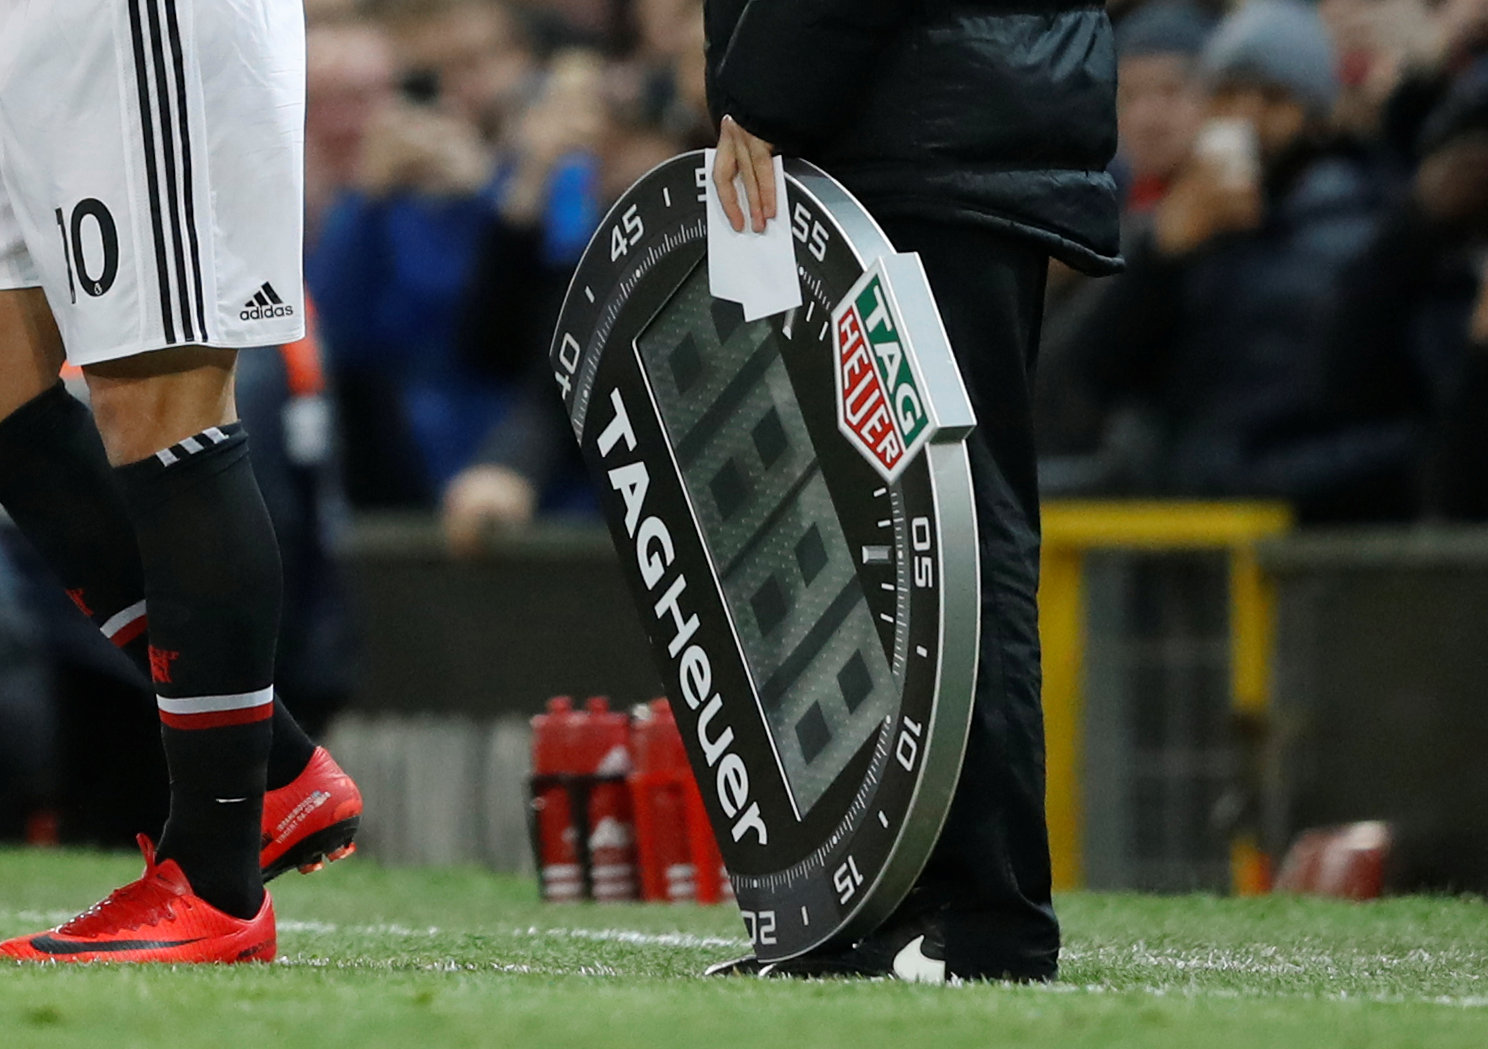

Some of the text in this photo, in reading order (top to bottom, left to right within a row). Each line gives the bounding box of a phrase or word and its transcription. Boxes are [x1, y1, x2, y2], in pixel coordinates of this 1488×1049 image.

[611, 203, 644, 262] 45
[792, 202, 830, 262] 55
[240, 304, 294, 322] adidas
[840, 313, 900, 464] HEUER
[864, 284, 923, 436] TAG
[912, 517, 933, 589] 05
[896, 714, 923, 772] 10
[833, 854, 864, 905] 15
